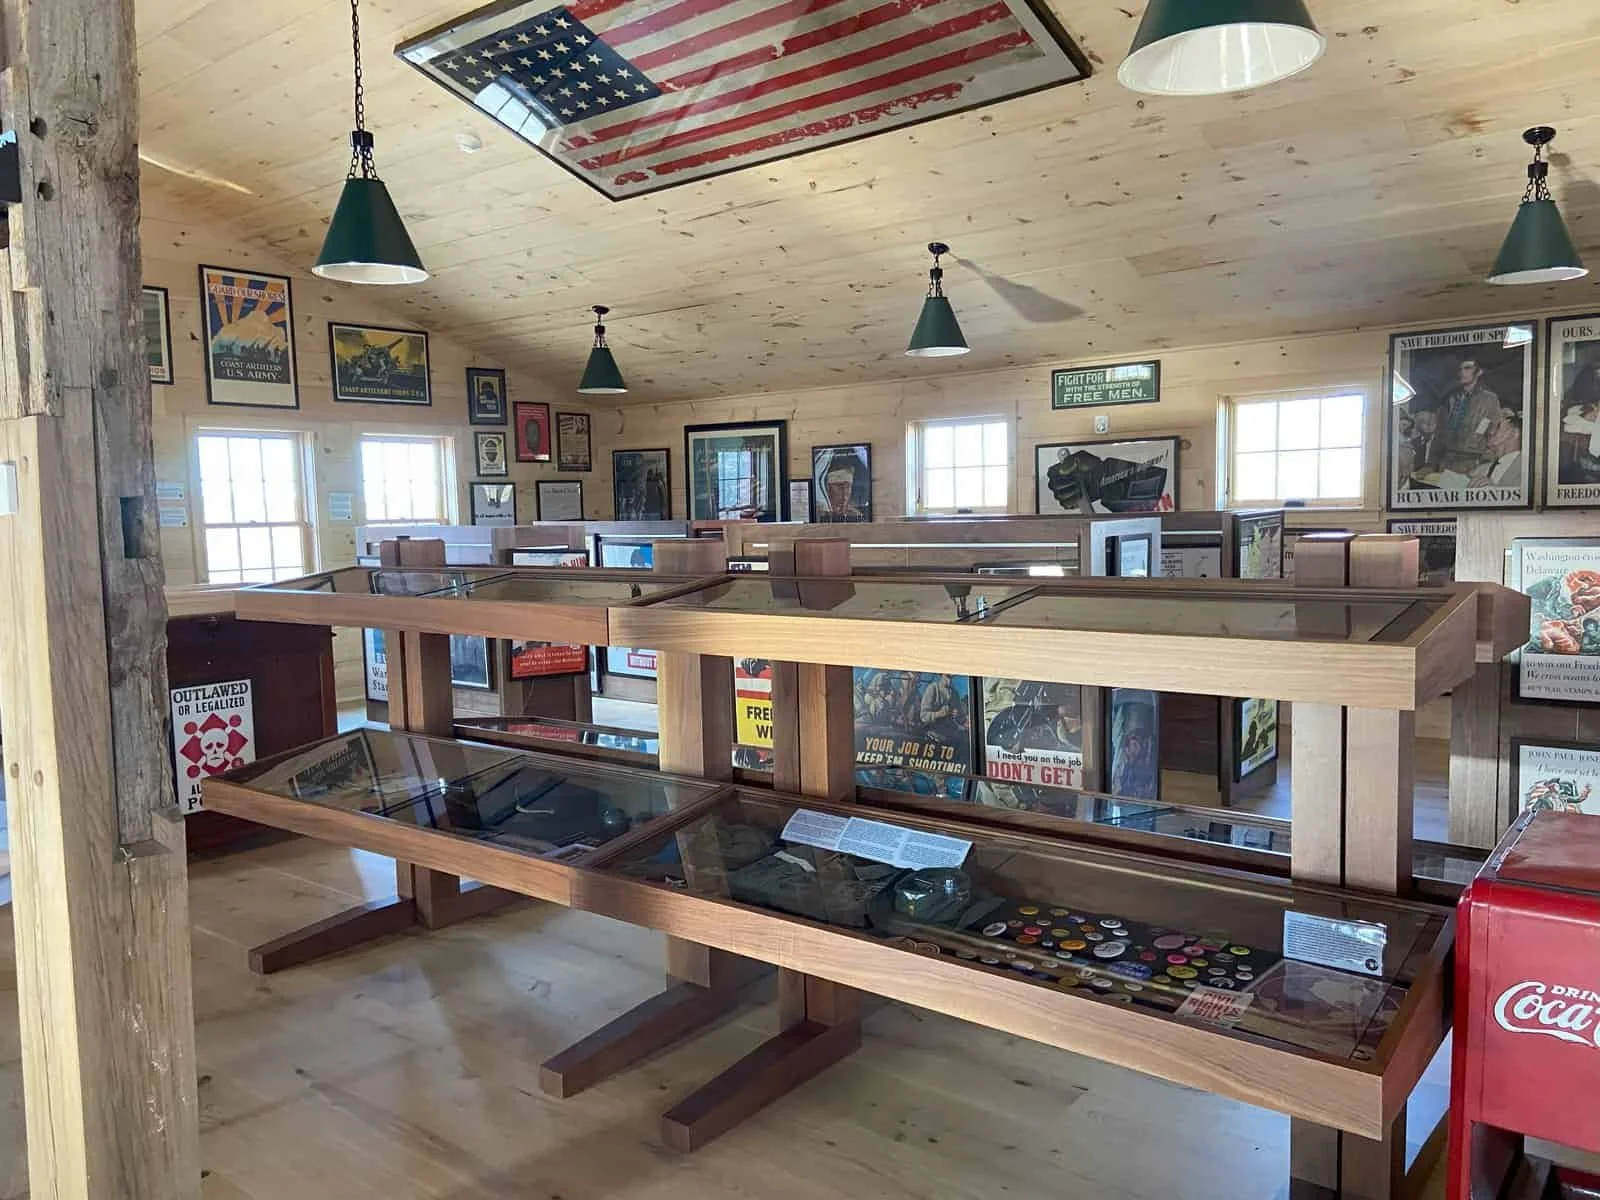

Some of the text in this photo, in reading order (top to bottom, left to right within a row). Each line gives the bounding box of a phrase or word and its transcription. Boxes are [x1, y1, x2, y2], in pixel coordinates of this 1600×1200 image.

[1424, 333, 1471, 346] FREEDOM
[1562, 326, 1593, 338] OURS
[247, 370, 278, 380] ARMY
[1058, 374, 1085, 387] FIGHT
[1086, 372, 1105, 385] FOR
[1063, 387, 1147, 403] FREE MEN.
[1397, 488, 1522, 504] BUY WAR BONDS
[1557, 486, 1600, 500] FREEDO
[1420, 523, 1457, 535] FREEDO
[173, 682, 249, 704] OUTLAWED
[178, 696, 246, 717] OR LEGALIZED
[756, 724, 773, 739] WI
[864, 736, 955, 760] YOUR JOB IS TO
[856, 751, 884, 764] KEEP
[908, 758, 967, 775] SHOOTING!
[1002, 752, 1022, 761] need
[1024, 754, 1038, 763] you
[1053, 756, 1066, 765] the
[1068, 757, 1082, 769] job
[1528, 750, 1600, 763] JOHN PAUL JONE
[988, 760, 1035, 782] DON'T
[1040, 766, 1074, 787] GET
[1550, 984, 1600, 1002] DRIN
[1494, 981, 1600, 1048] Coca
